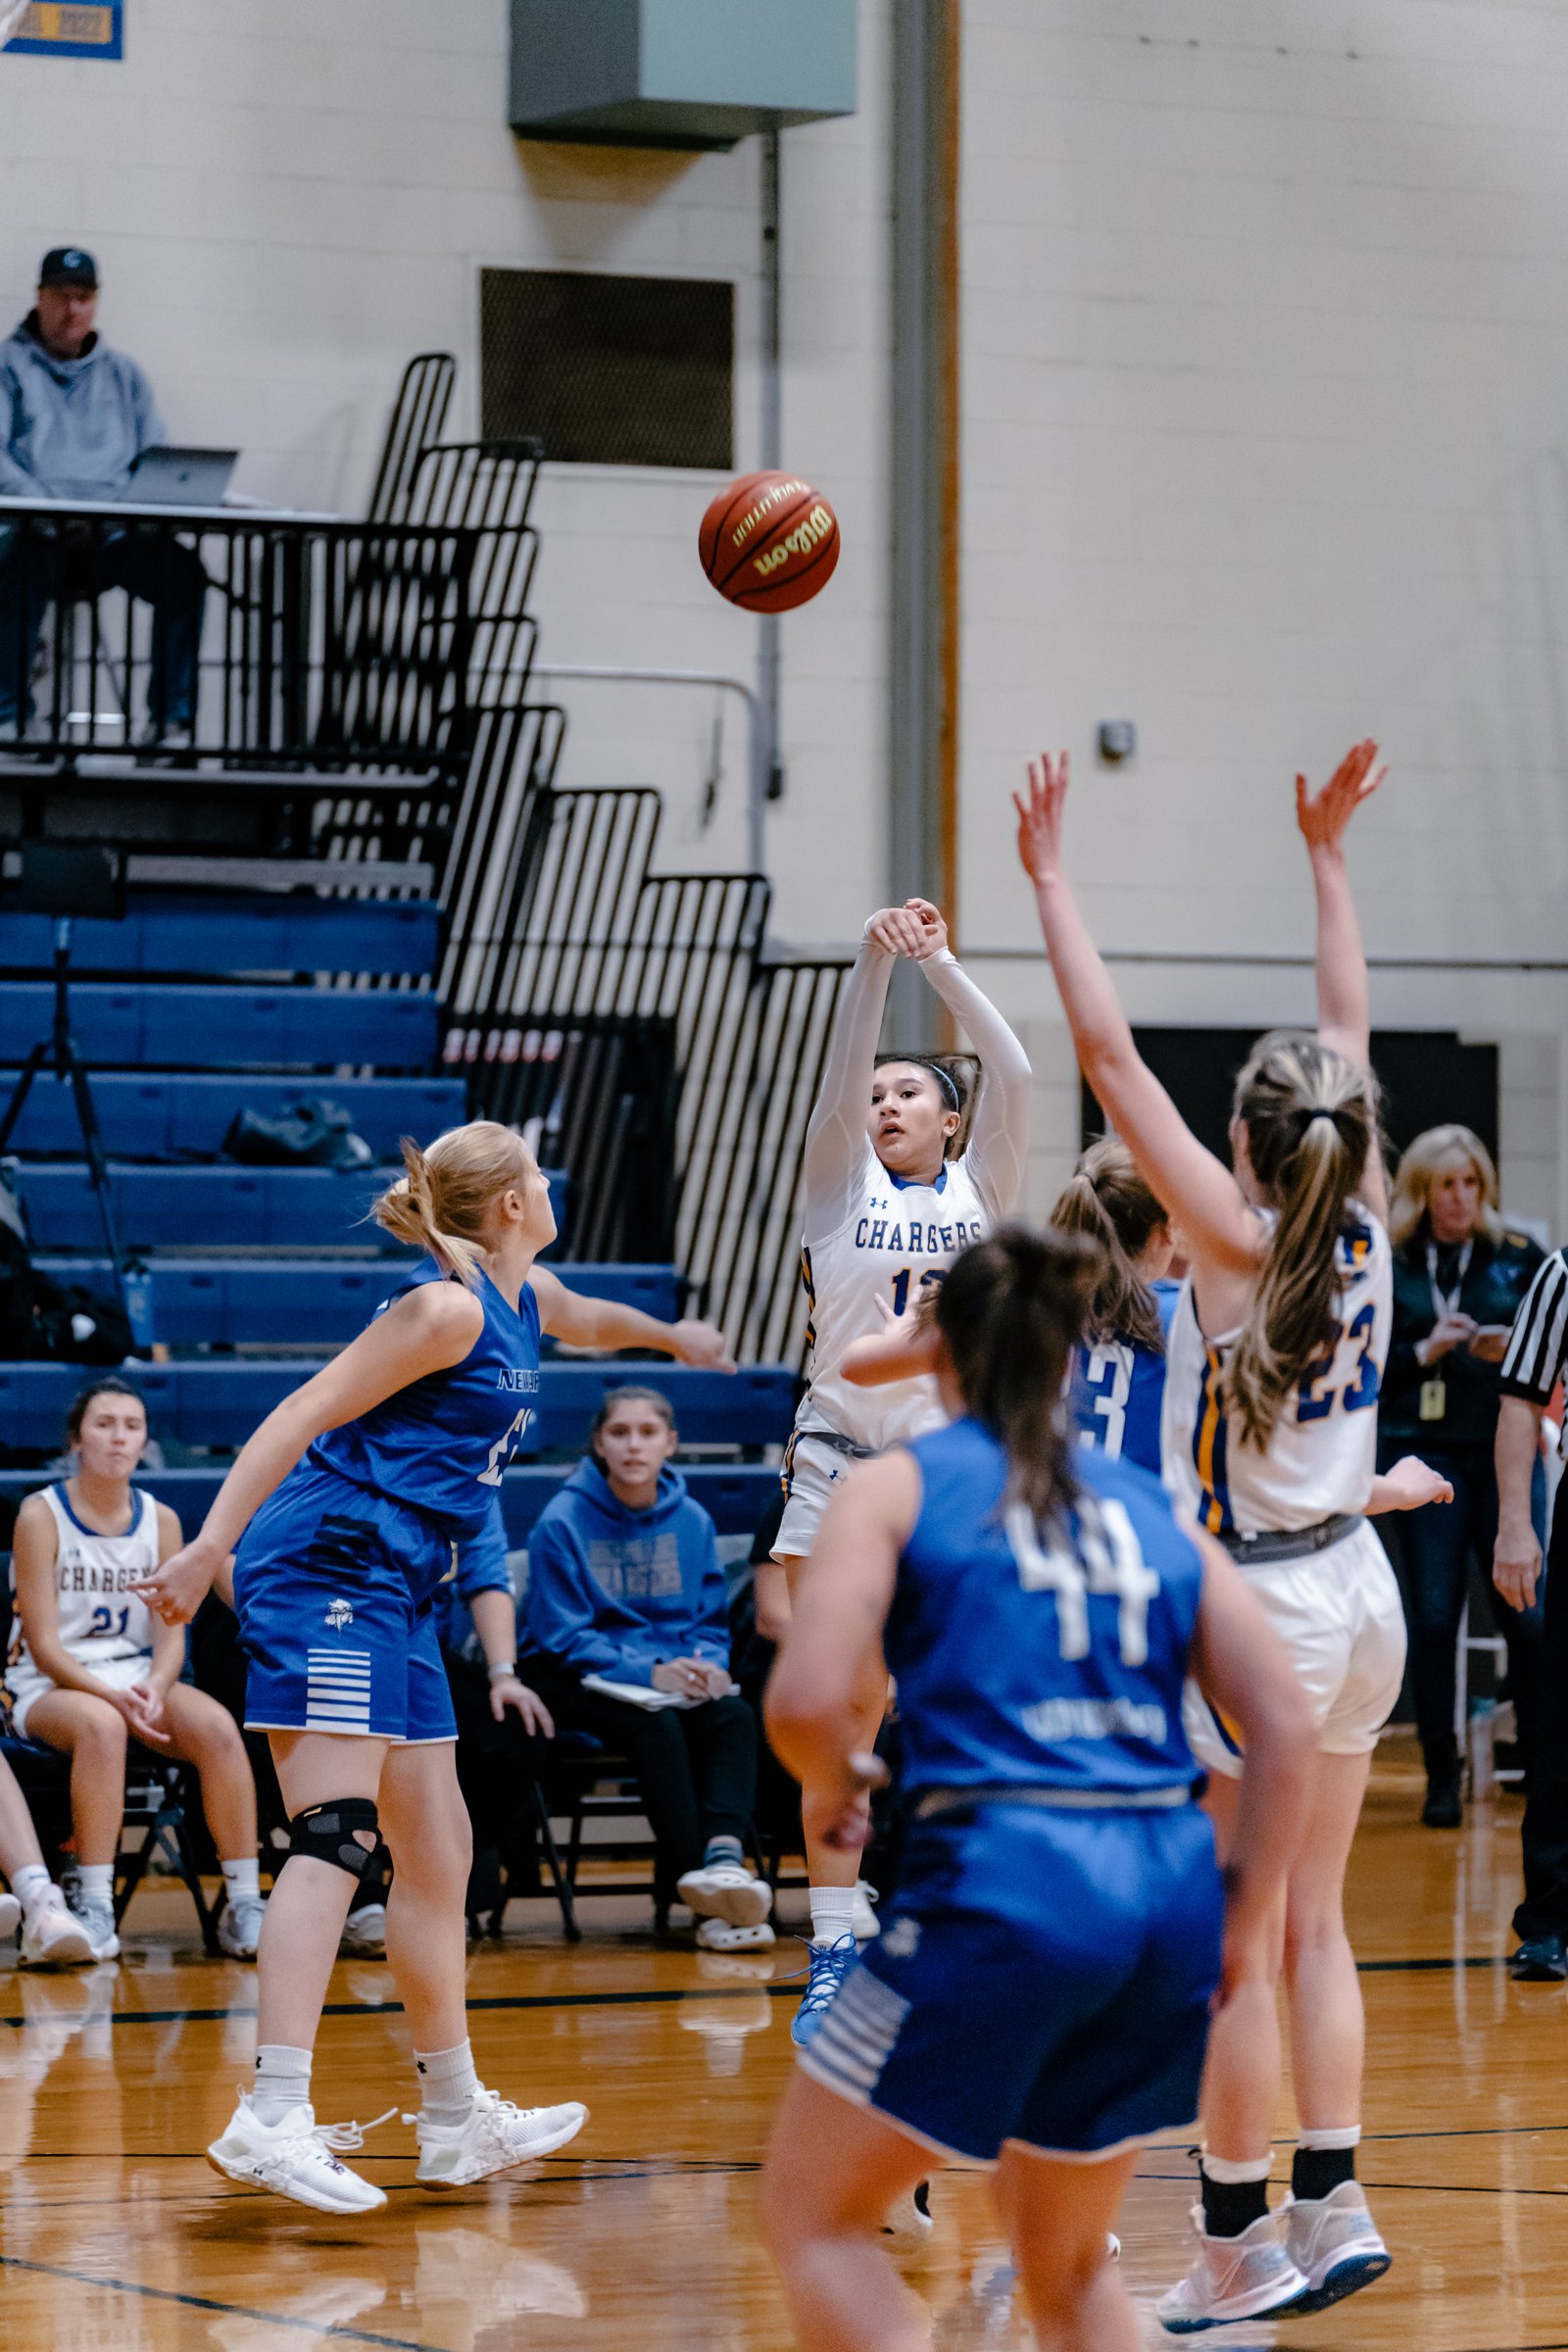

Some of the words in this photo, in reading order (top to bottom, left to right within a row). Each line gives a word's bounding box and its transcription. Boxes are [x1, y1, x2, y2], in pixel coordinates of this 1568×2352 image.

[754, 504, 833, 576] Wilson
[1005, 1496, 1160, 1667] 44
[86, 1605, 129, 1638] 21
